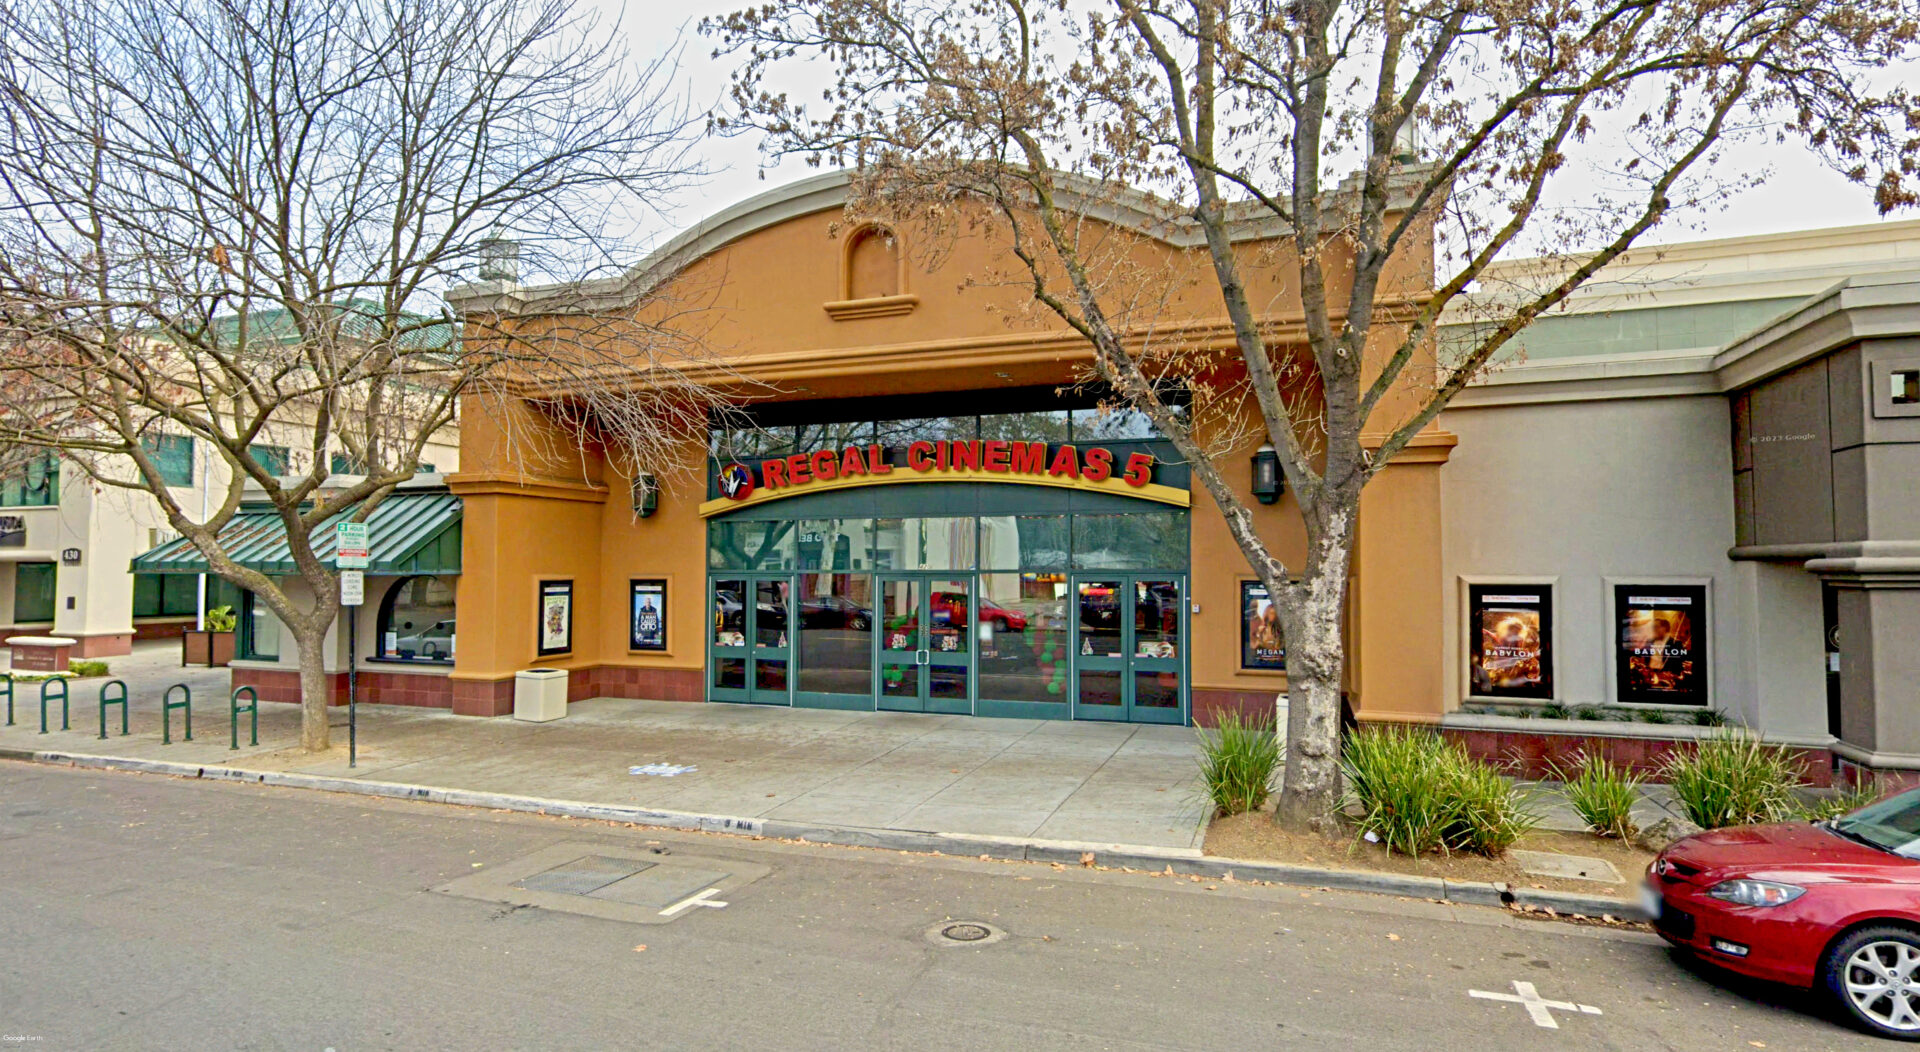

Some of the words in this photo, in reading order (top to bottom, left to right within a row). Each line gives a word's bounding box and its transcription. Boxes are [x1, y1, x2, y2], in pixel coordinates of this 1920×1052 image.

[761, 444, 894, 490] REGAL
[907, 440, 1114, 481] CINEMAS
[1123, 452, 1154, 487] 5
[64, 550, 79, 560] 430
[1485, 649, 1534, 658] BABYLON
[1634, 648, 1688, 656] BABYLON
[737, 820, 753, 830] MIN
